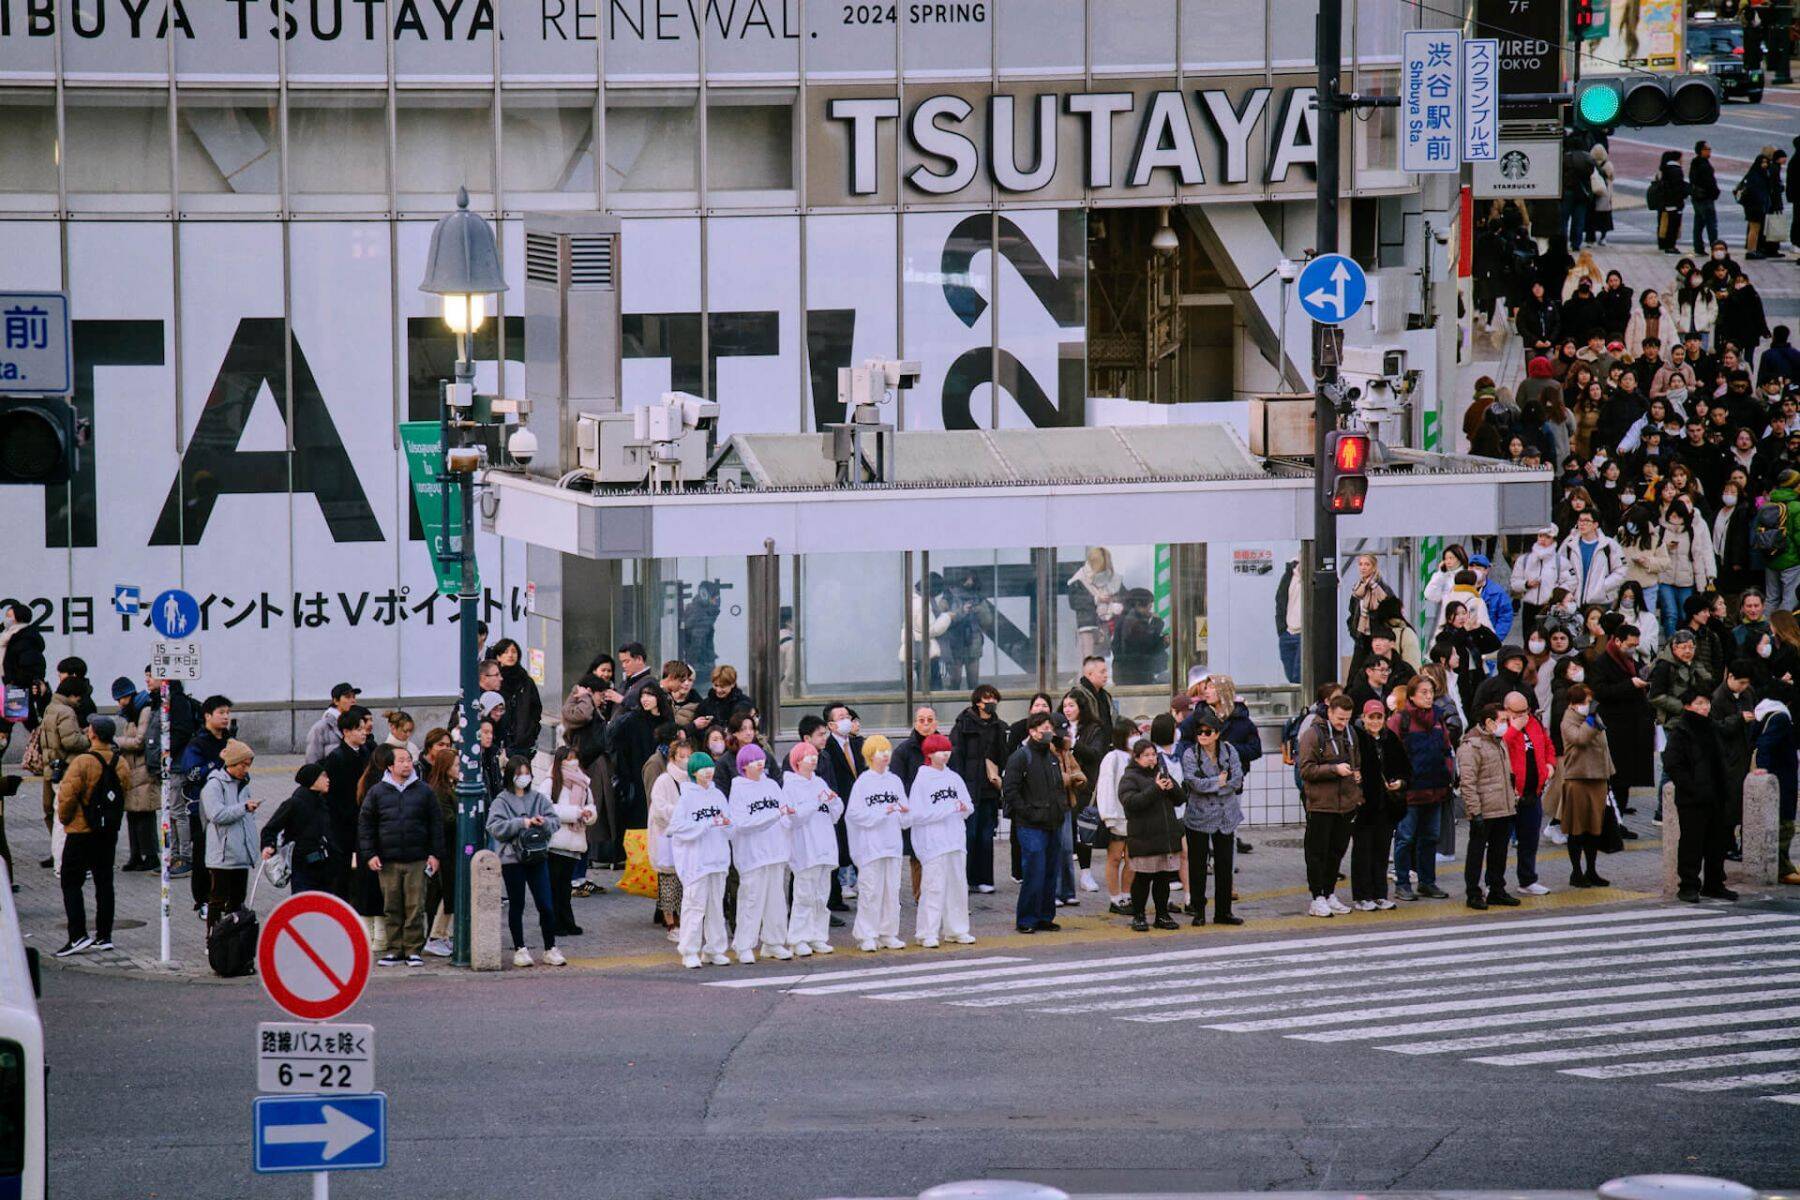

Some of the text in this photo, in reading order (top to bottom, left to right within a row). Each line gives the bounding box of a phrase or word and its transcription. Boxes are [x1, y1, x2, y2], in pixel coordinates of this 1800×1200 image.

[226, 0, 504, 40] TSUTAYA
[542, 0, 817, 40] RENEWAL.
[843, 5, 897, 24] 2024
[910, 3, 985, 23] SPRING
[1509, 1, 1529, 14] 7F
[1498, 58, 1541, 70] OKYO
[1408, 60, 1424, 147] Shibuya Sta.
[1427, 42, 1452, 160] 渋谷駅前
[829, 87, 1318, 194] TSUTAYA
[4, 305, 48, 349] 前
[0, 362, 26, 379] a.
[262, 1030, 367, 1055] 路線バスを除く
[278, 1063, 352, 1088] 6-22
